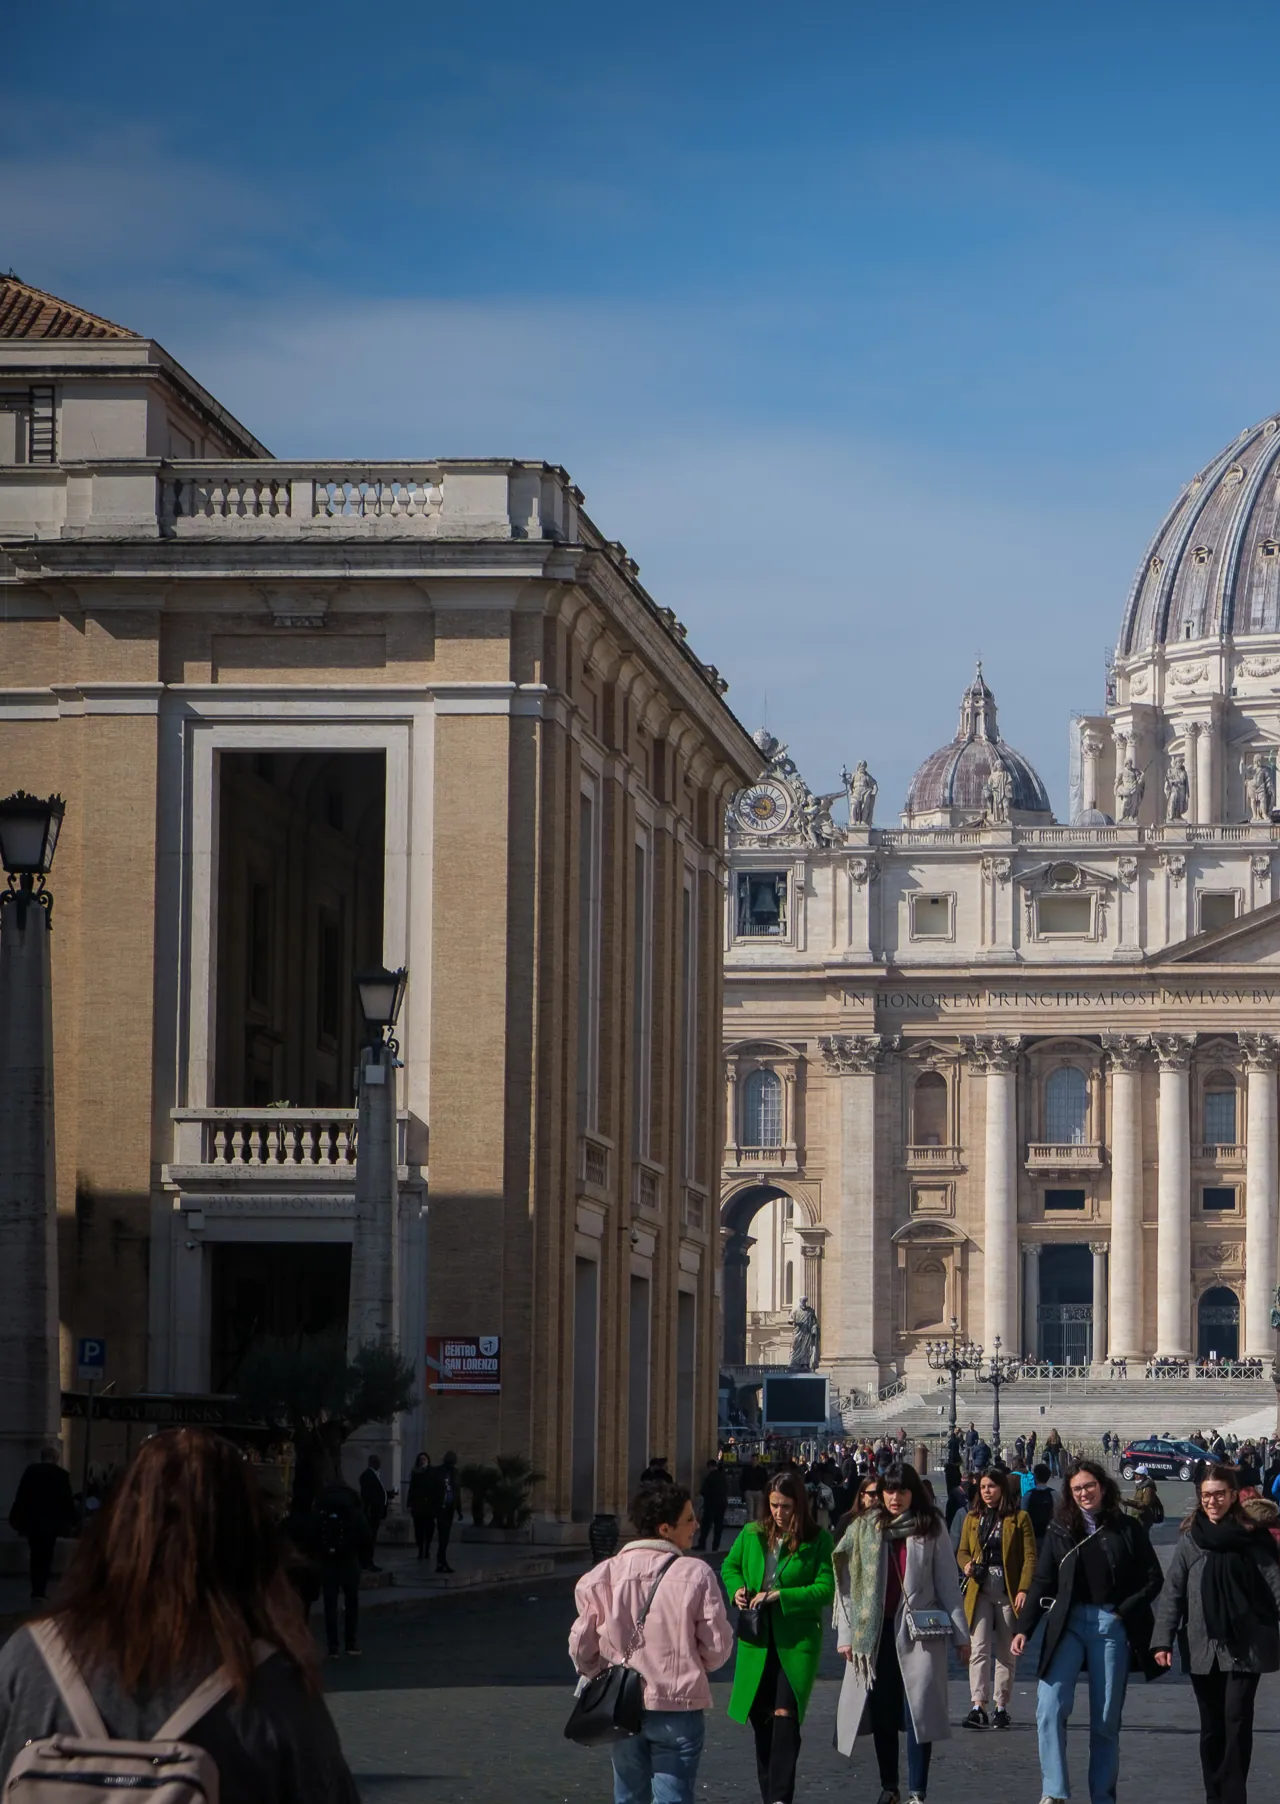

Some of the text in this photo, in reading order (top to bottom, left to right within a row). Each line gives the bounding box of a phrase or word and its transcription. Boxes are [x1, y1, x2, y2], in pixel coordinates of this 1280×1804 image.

[843, 992, 866, 1007] IN
[876, 992, 981, 1008] HONOREM
[987, 991, 1091, 1007] PRINCIPIS
[1095, 990, 1156, 1006] APOST
[1162, 989, 1230, 1005] PAVLVS
[1233, 990, 1246, 1004] V
[84, 1341, 101, 1364] P
[445, 1344, 476, 1356] CENTRO
[445, 1358, 498, 1371] SAN LORENZO
